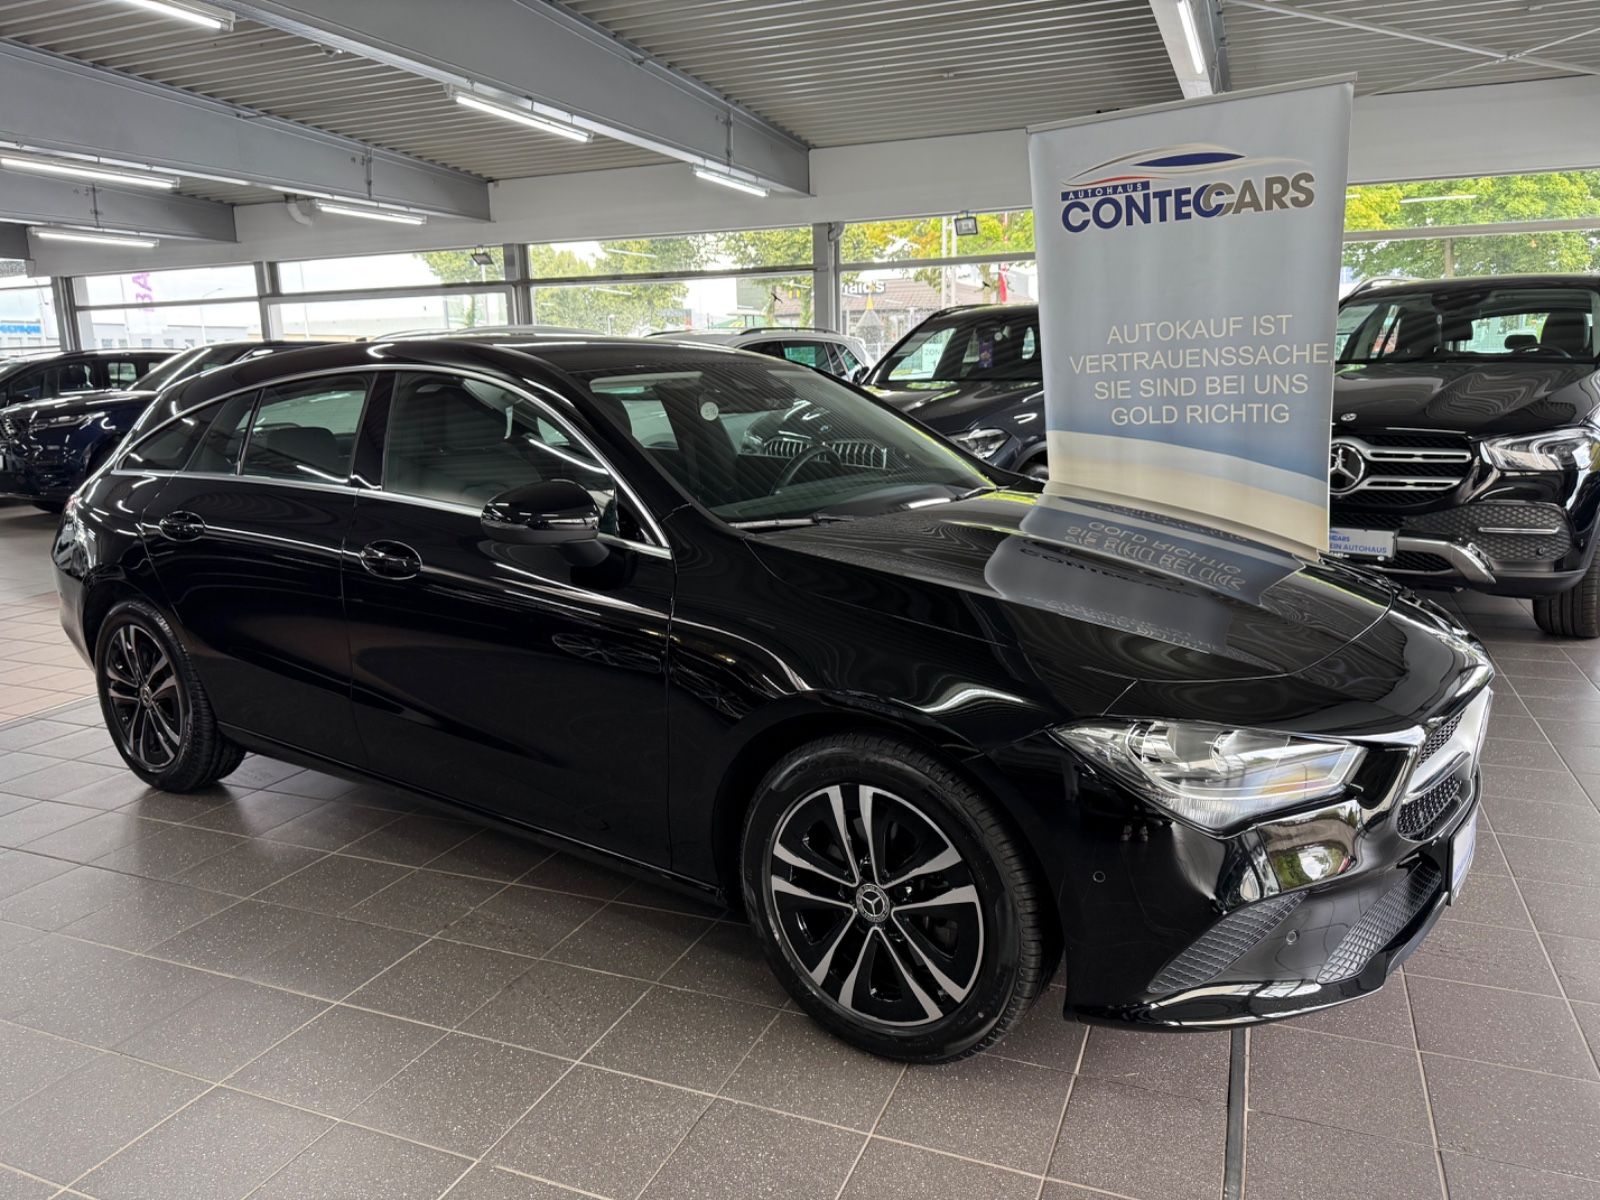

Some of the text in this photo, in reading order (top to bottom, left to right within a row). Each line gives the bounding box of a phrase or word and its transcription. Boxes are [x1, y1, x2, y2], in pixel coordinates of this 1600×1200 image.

[1068, 183, 1143, 200] AUTOHAUS
[1107, 314, 1293, 345] AUTOKAUF IST
[1069, 343, 1334, 375] VERTRAUENSSACHE,
[1094, 373, 1309, 400] SIE SIND BEI UNS
[1111, 402, 1290, 426] GOLD RICHTIG
[1343, 544, 1388, 554] AUTOHAUS
